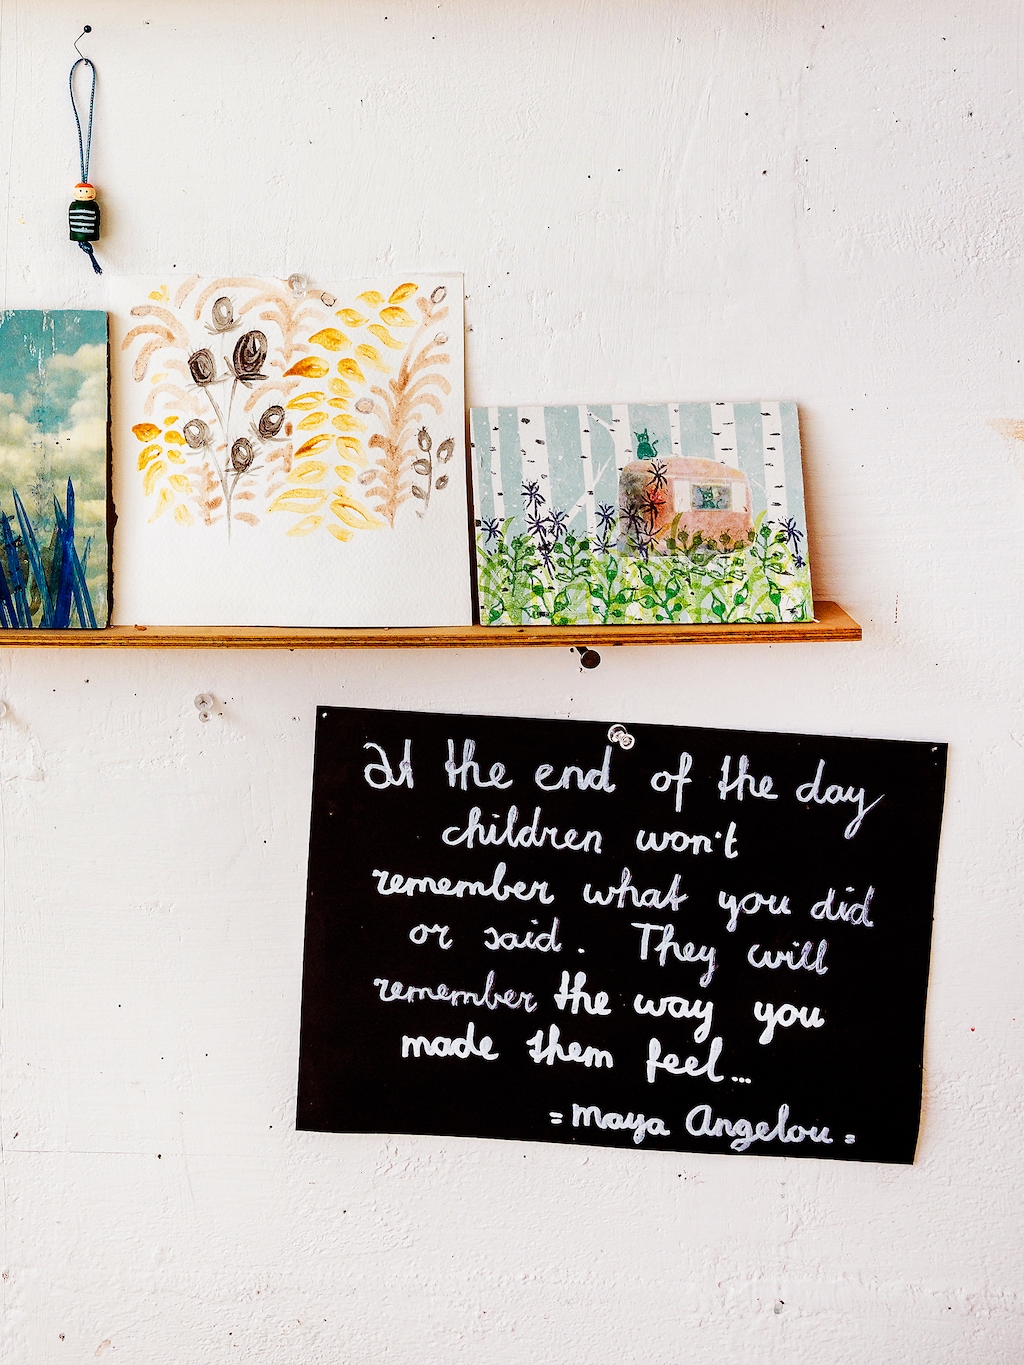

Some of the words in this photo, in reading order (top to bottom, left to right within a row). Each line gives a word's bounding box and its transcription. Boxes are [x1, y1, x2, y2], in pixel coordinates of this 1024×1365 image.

[444, 739, 513, 790] the
[535, 745, 616, 792] end
[651, 752, 692, 812] of
[718, 755, 778, 801] the
[796, 759, 885, 839] day
[442, 805, 602, 854] children
[372, 862, 555, 904] remember
[584, 867, 689, 911] what
[719, 891, 791, 932] you
[811, 886, 874, 927] did
[409, 923, 453, 949] or
[631, 923, 718, 987] They
[747, 939, 828, 974] will
[373, 970, 538, 1013] remember
[553, 970, 612, 1015] the
[633, 994, 714, 1043] way
[754, 1001, 825, 1045] you
[401, 1022, 499, 1060] made
[527, 1024, 614, 1068] them
[685, 1104, 833, 1151] Angelou
